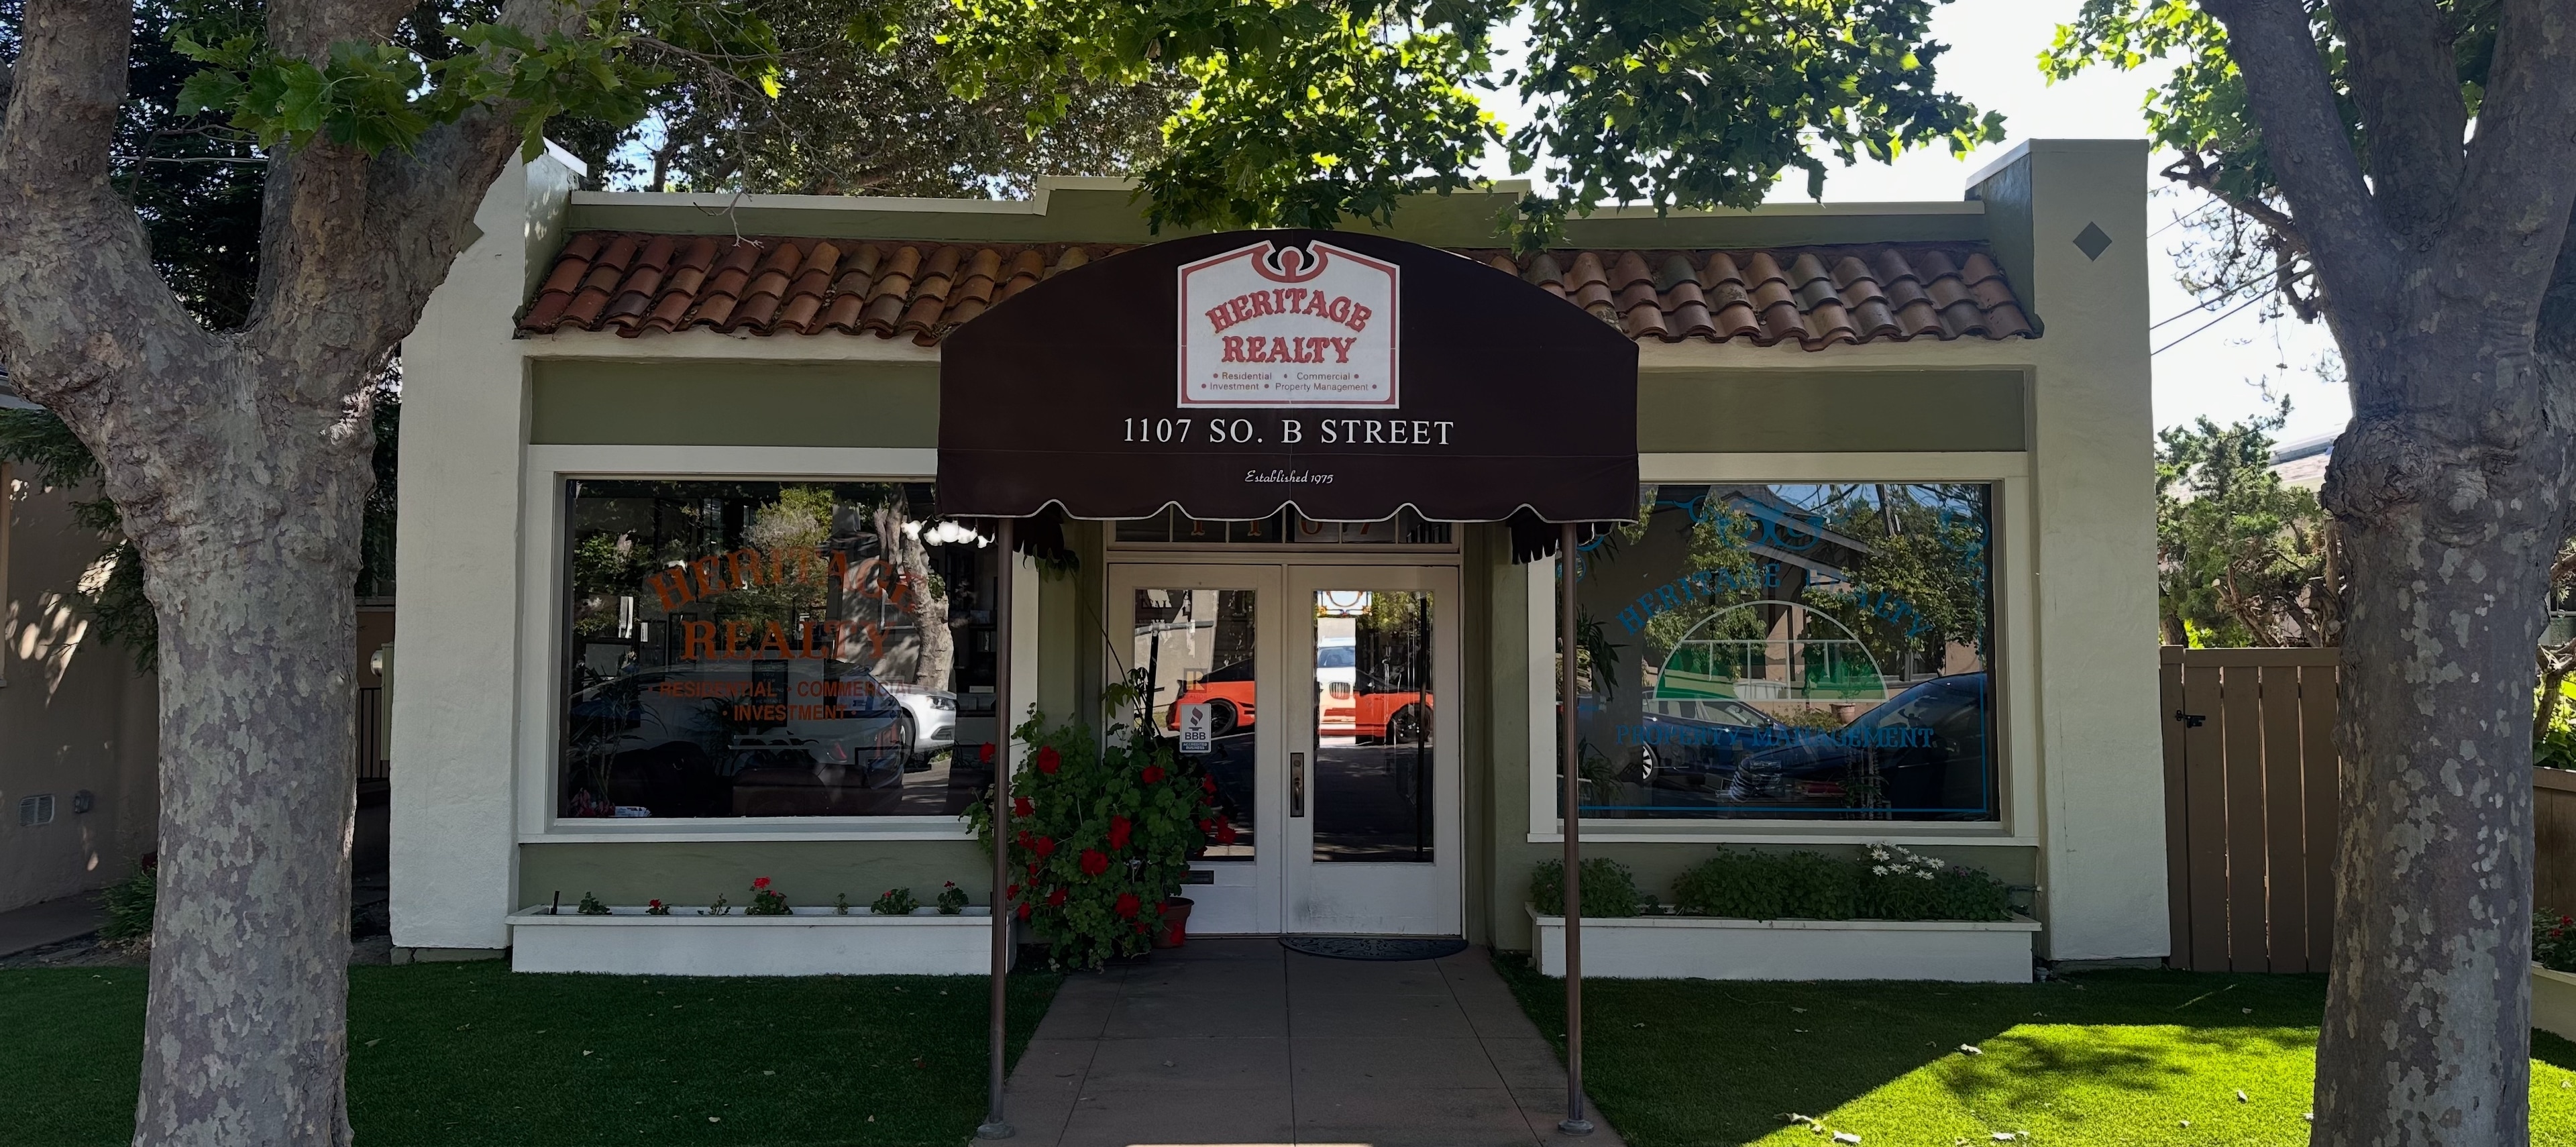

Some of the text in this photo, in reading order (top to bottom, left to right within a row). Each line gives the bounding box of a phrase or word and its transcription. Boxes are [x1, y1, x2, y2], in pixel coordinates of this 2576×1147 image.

[1205, 288, 1372, 335] HERITAGE
[1222, 336, 1357, 364] REALTY
[1210, 382, 1368, 392] Investment Property Management
[1222, 372, 1350, 380] Residential Commercial
[1124, 418, 1454, 445] 1107 SO. B STREET
[1244, 470, 1334, 485] Established 1975
[646, 546, 923, 614] HERITAGE
[1615, 562, 1781, 637] HERITAGE
[680, 619, 899, 661] REALTY
[659, 680, 913, 698] RESIDENTIAL COMMERCIAL
[734, 704, 848, 722] INVESTMENT
[1185, 732, 1206, 740] BBB
[1615, 724, 1935, 749] PROPERTY MANAGEMENT
